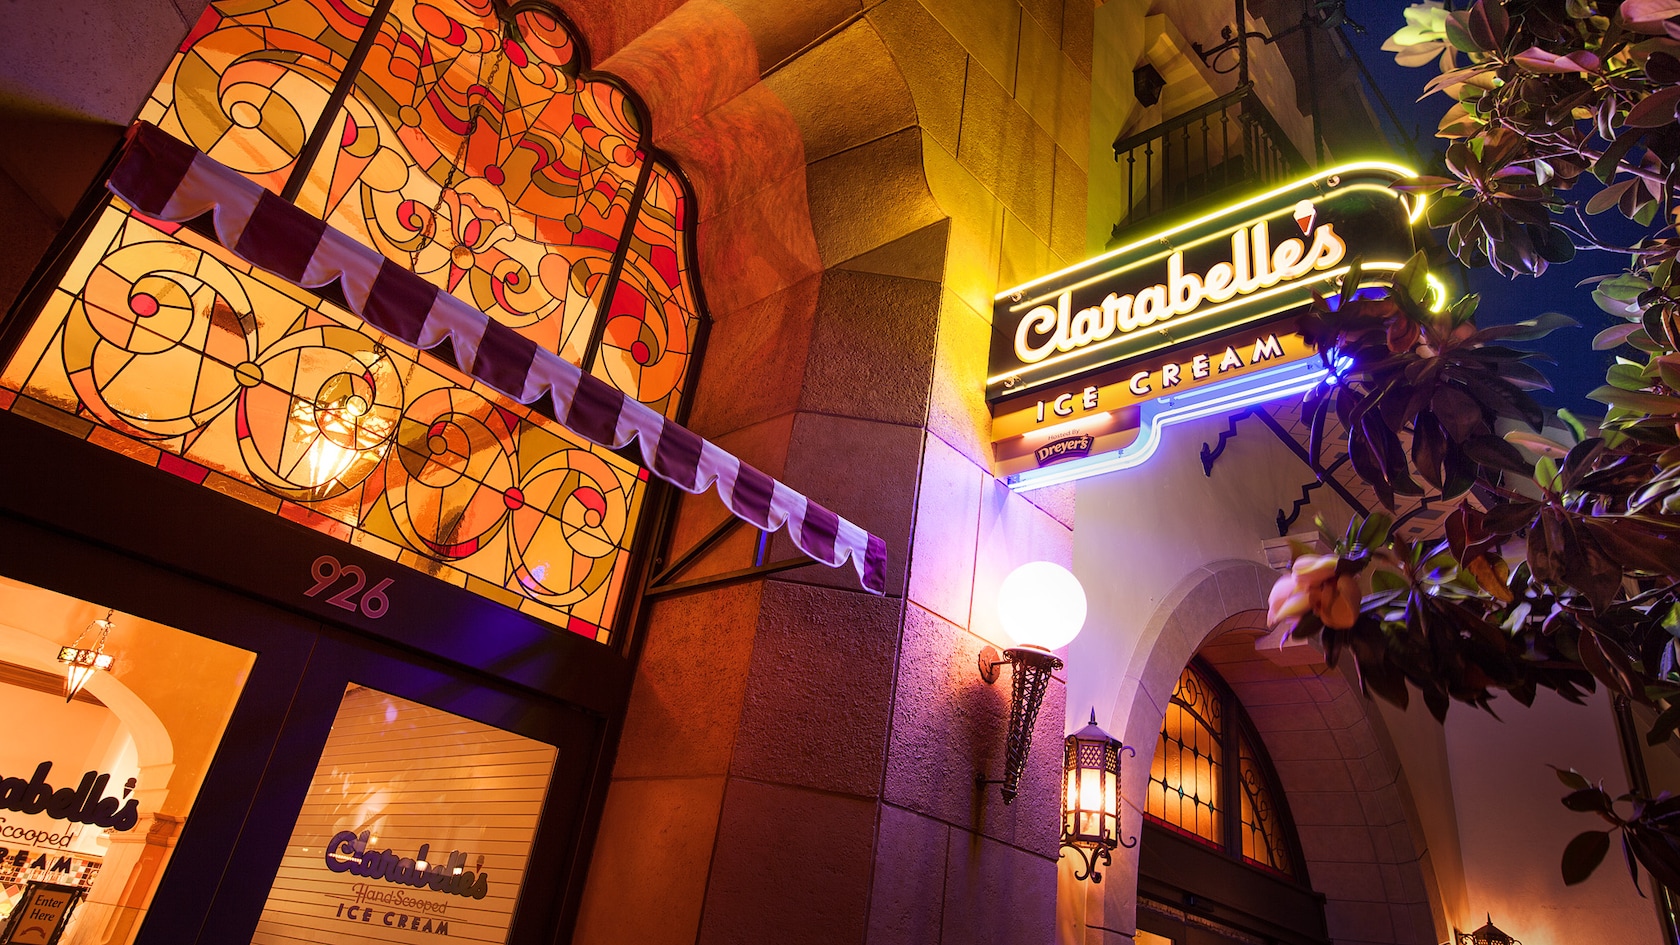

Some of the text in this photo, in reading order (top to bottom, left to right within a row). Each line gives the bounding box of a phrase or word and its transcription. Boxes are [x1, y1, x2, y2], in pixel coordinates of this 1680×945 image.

[1014, 199, 1347, 363] Clarabelle's
[1036, 333, 1285, 424] ICE CREAM
[1038, 435, 1089, 460] Dreyer's
[1048, 431, 1071, 441] Hosted
[303, 555, 395, 619] 926
[0, 760, 139, 832] abelle's
[325, 830, 489, 900] Clarabelle's
[29, 908, 56, 922] Here
[34, 894, 64, 909] Enter
[336, 903, 449, 936] ICE CREAM
